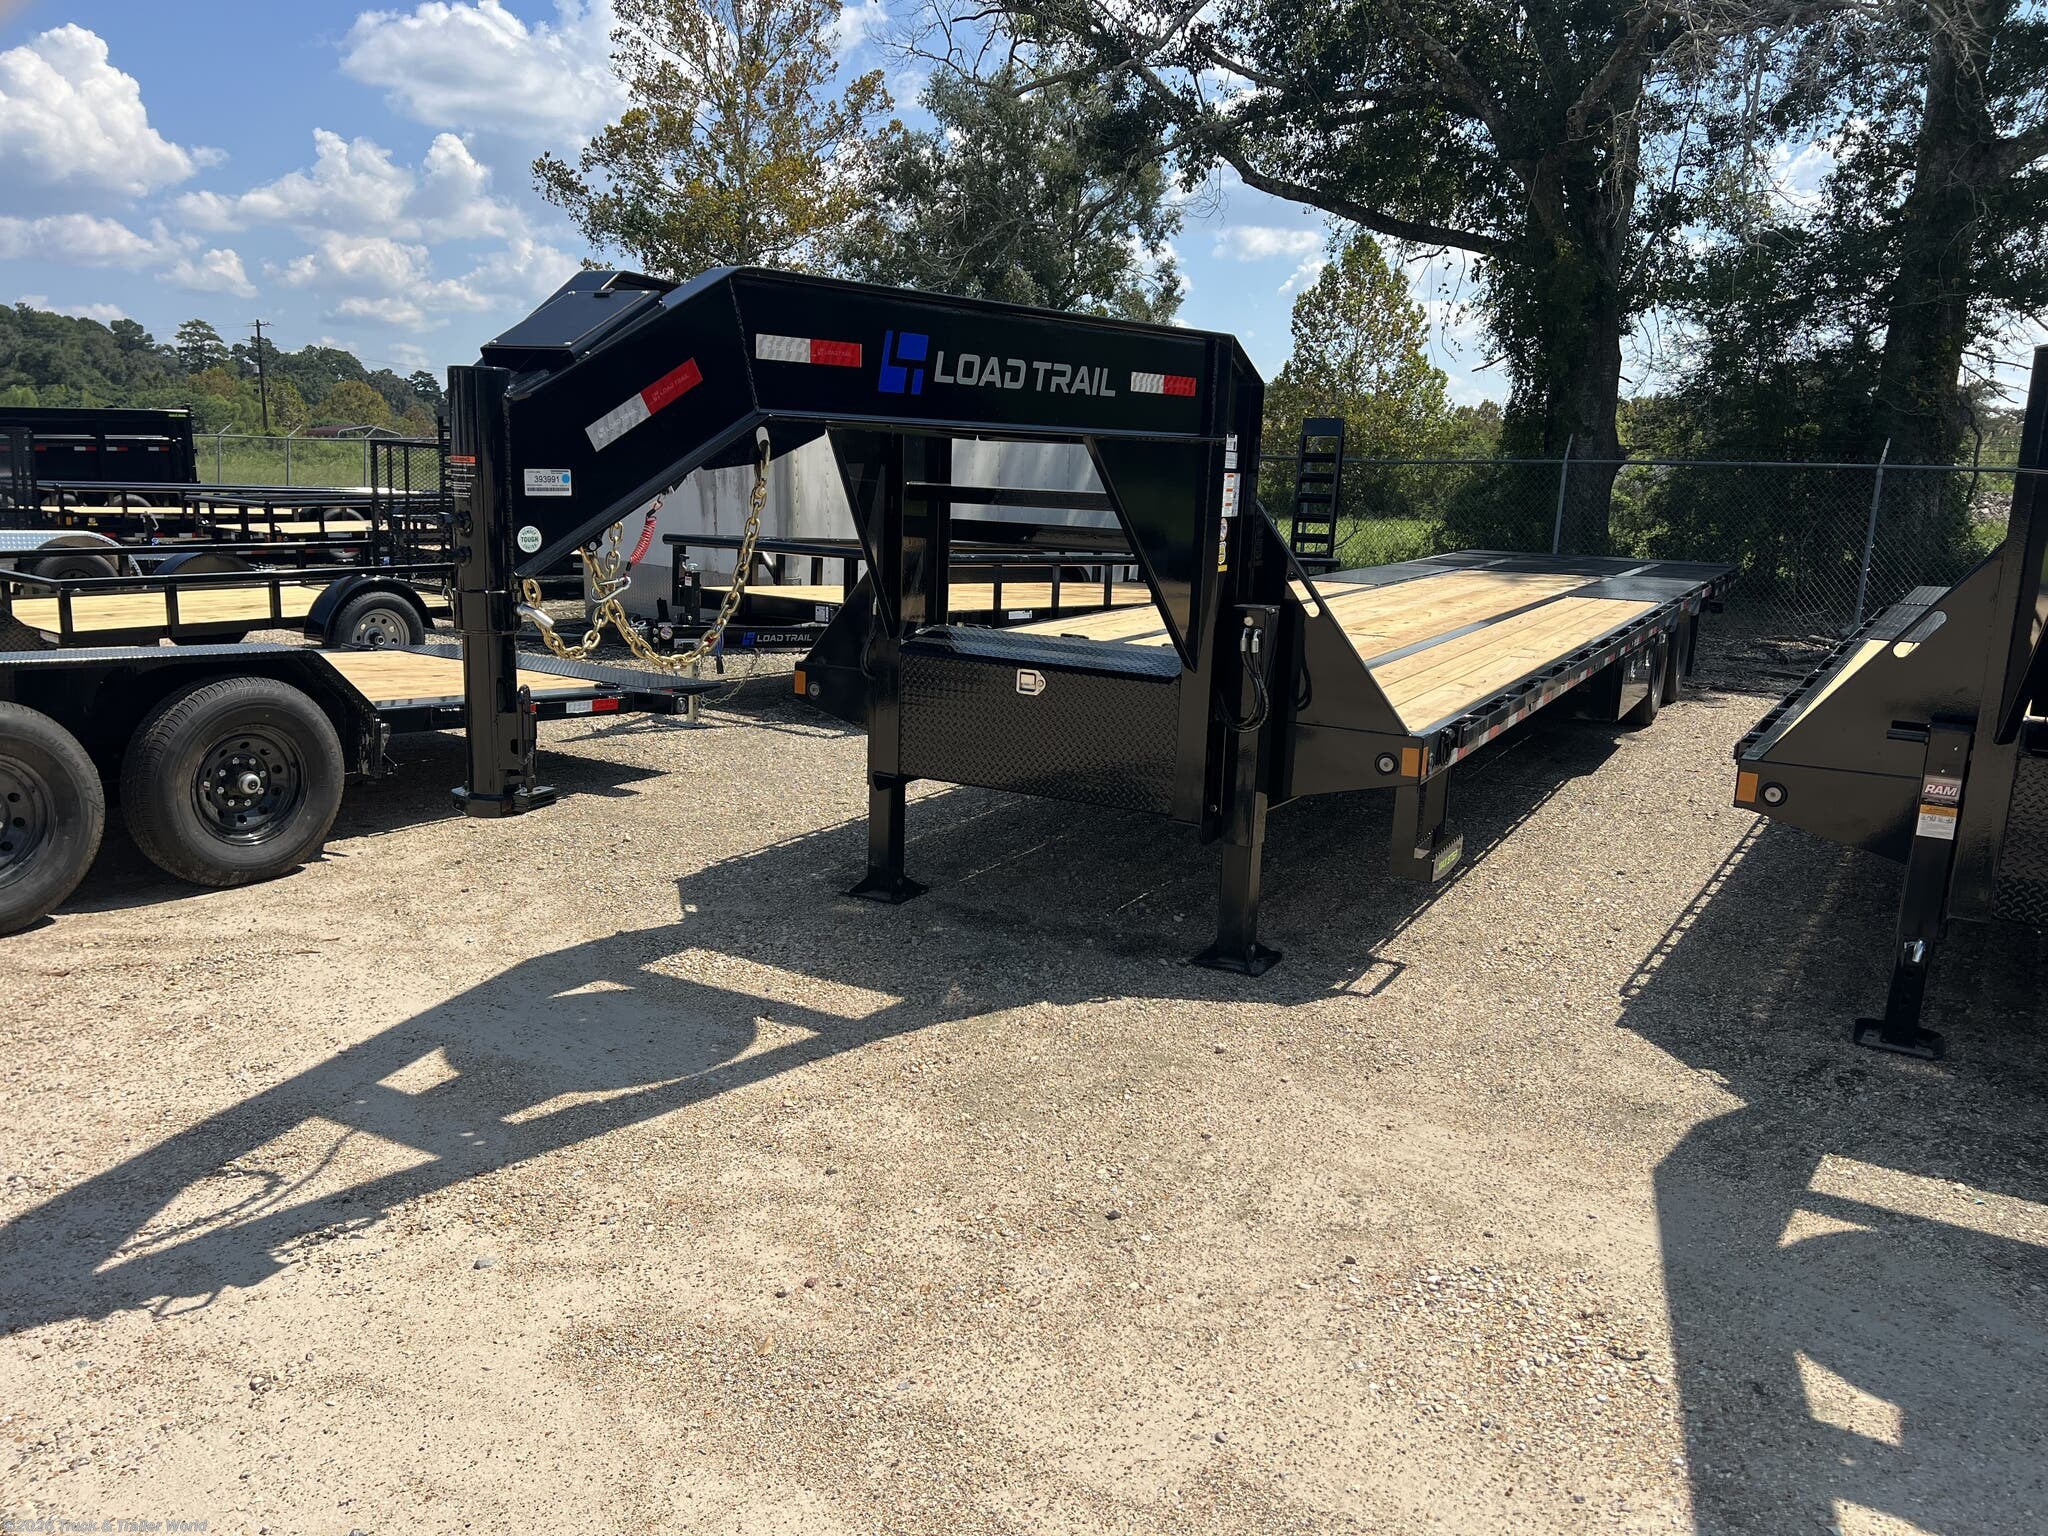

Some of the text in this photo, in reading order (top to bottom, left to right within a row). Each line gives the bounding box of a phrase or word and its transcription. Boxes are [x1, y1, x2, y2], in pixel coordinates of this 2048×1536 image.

[934, 351, 1116, 397] LOAD TRAIL
[534, 475, 560, 483] 393991
[757, 633, 812, 642] LOAD TRAIL
[1925, 784, 1957, 796] RAM
